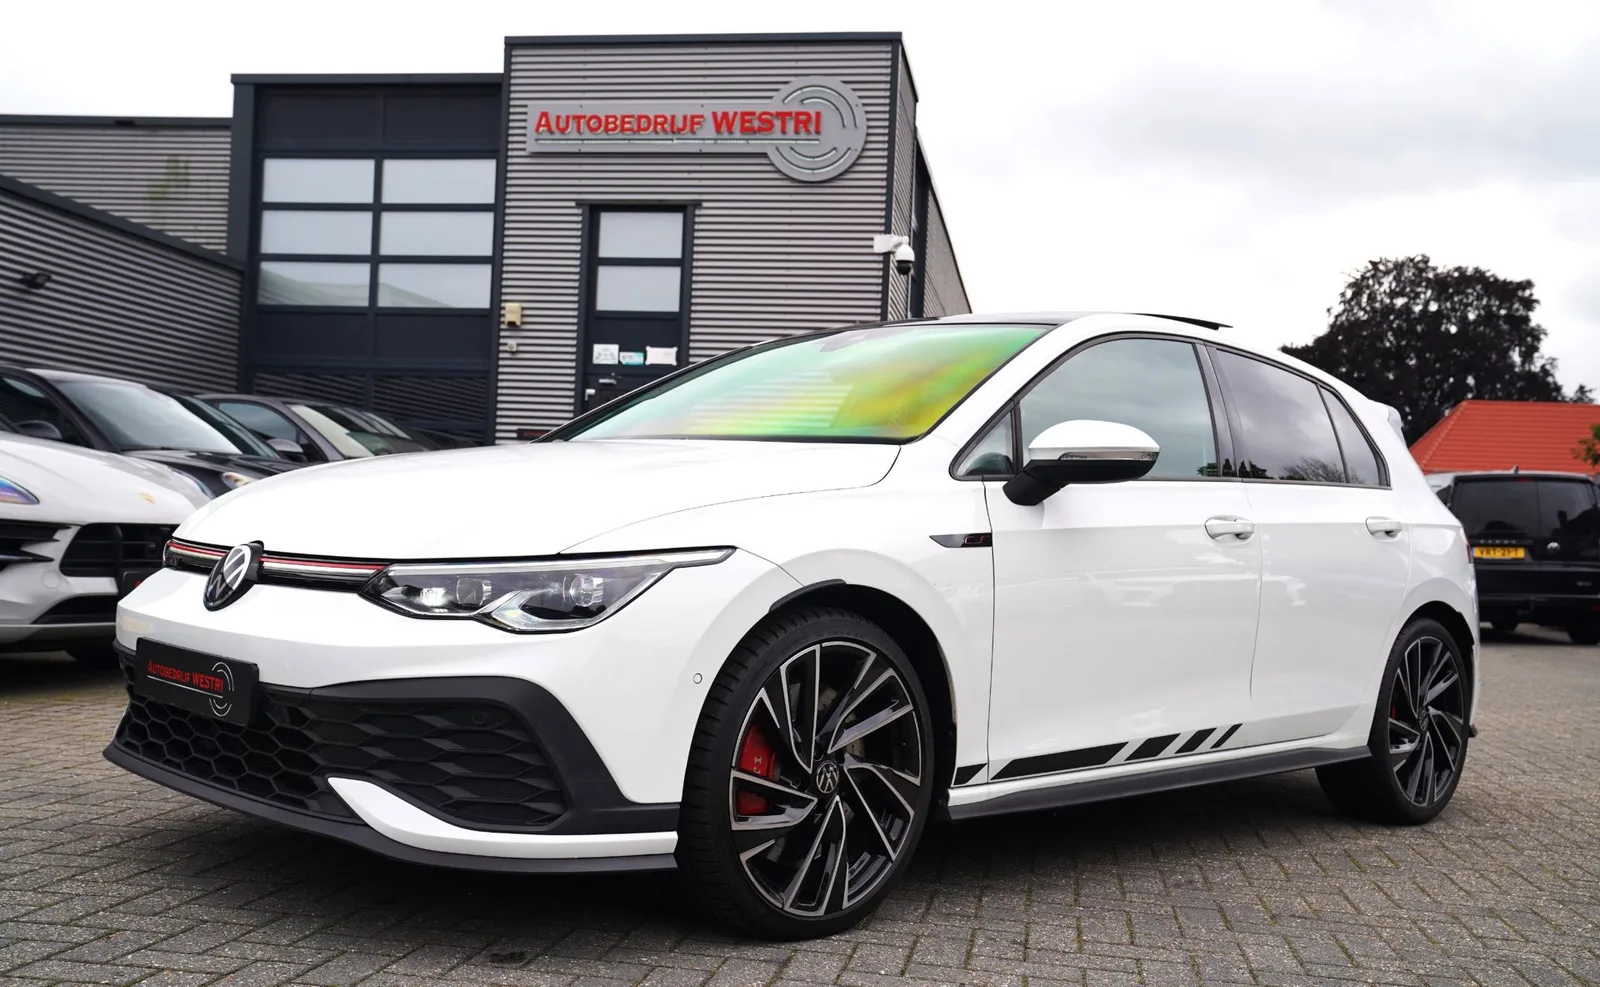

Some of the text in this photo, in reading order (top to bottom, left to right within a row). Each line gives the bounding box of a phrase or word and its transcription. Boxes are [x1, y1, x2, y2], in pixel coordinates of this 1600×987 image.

[534, 110, 822, 135] AUTOBEDRIJF WESTRI
[147, 660, 225, 693] AUTOBEDRIJF WESTRI
